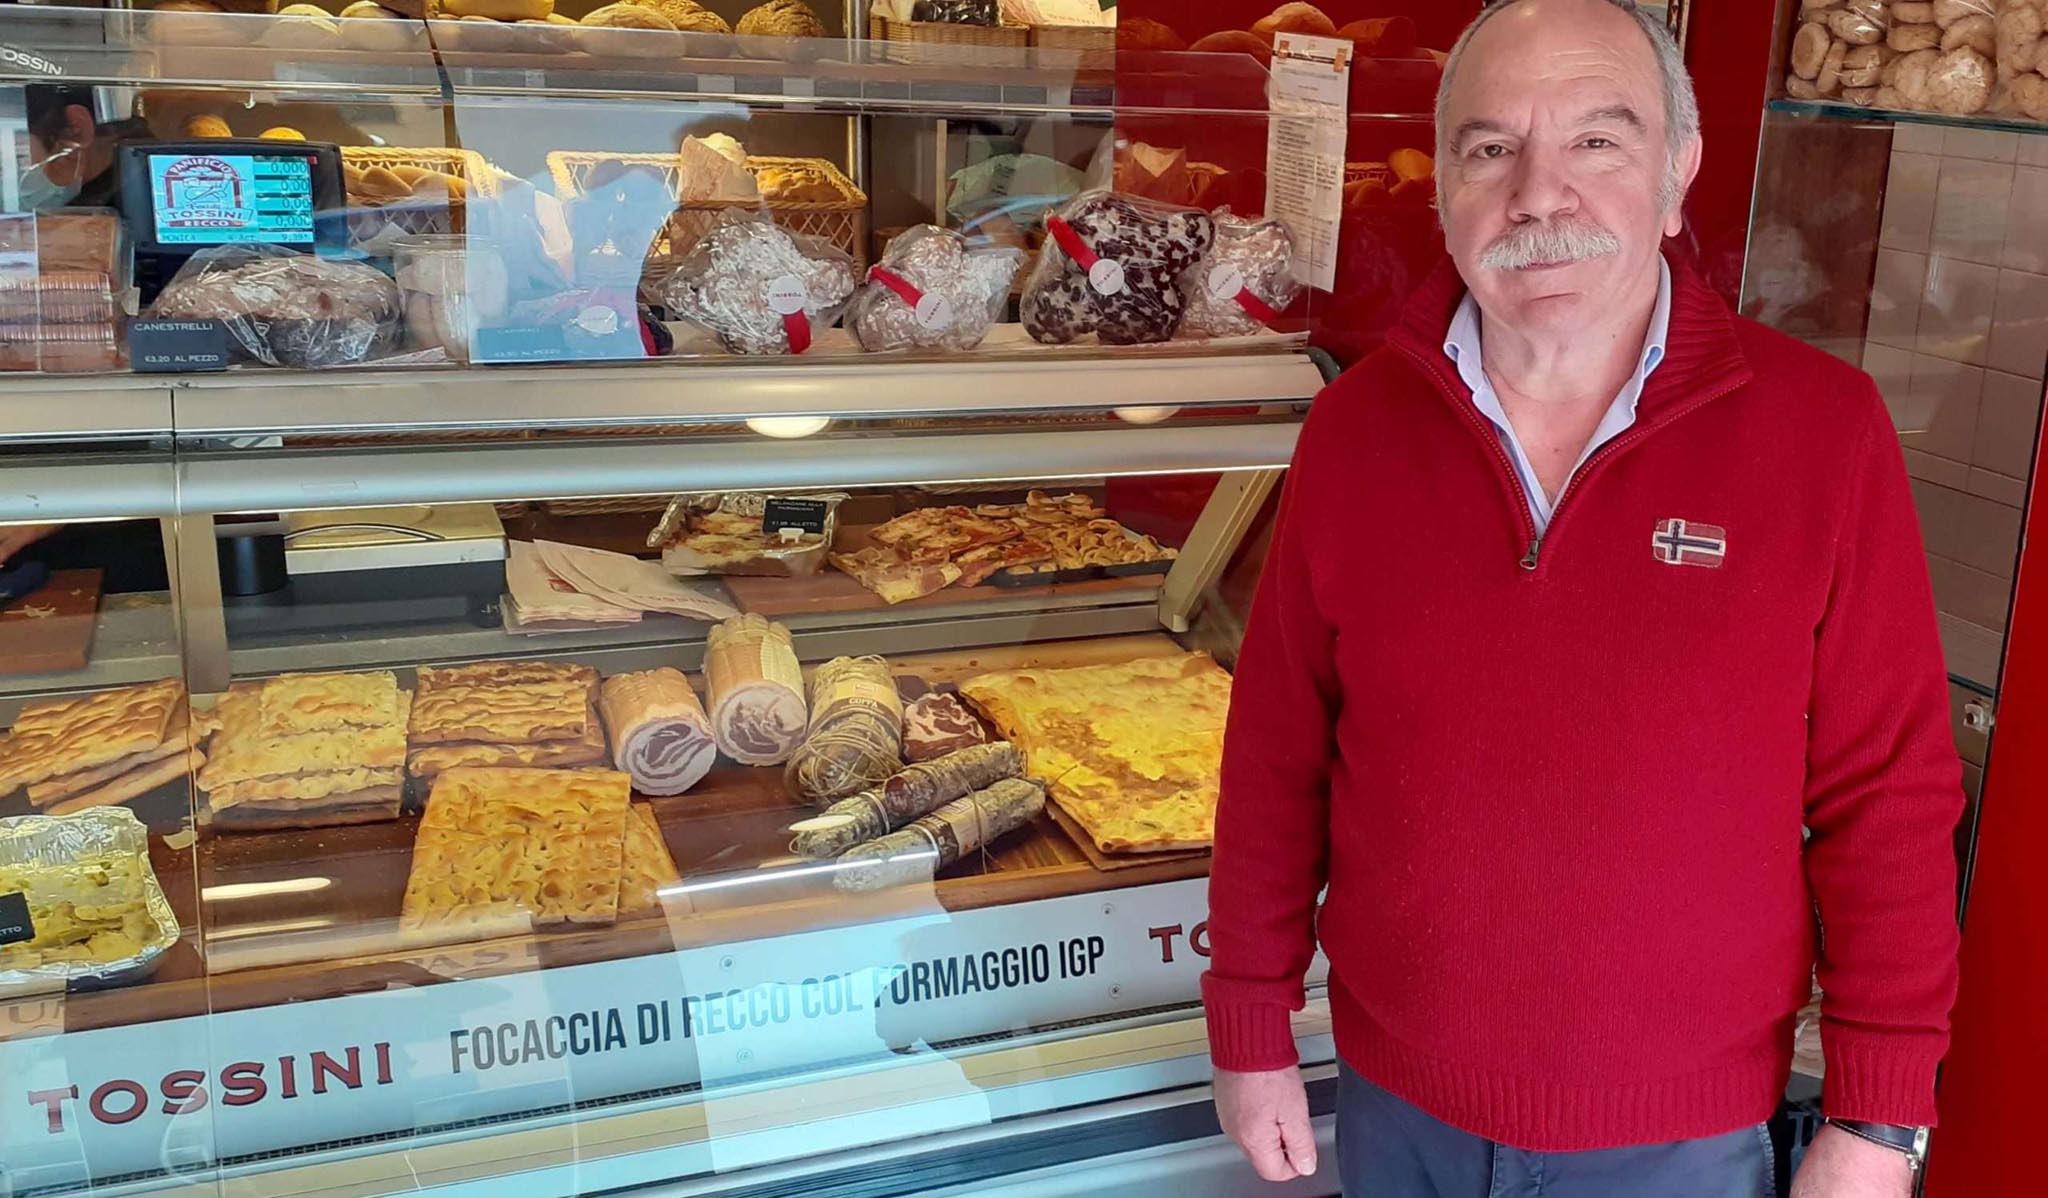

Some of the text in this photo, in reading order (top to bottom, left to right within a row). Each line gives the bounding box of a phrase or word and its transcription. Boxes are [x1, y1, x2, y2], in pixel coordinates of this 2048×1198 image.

[0, 47, 62, 75] OSSIN
[168, 157, 232, 176] PANIFICIO
[168, 208, 243, 220] TOSSINI
[134, 322, 213, 332] CANESTRELLI
[174, 354, 187, 362] AL
[188, 354, 219, 362] PEZZO
[450, 935, 1105, 1074] FOCACCIA DI RECCO COL FORMAGGIO IGP
[28, 1042, 393, 1134] TOSSINI
